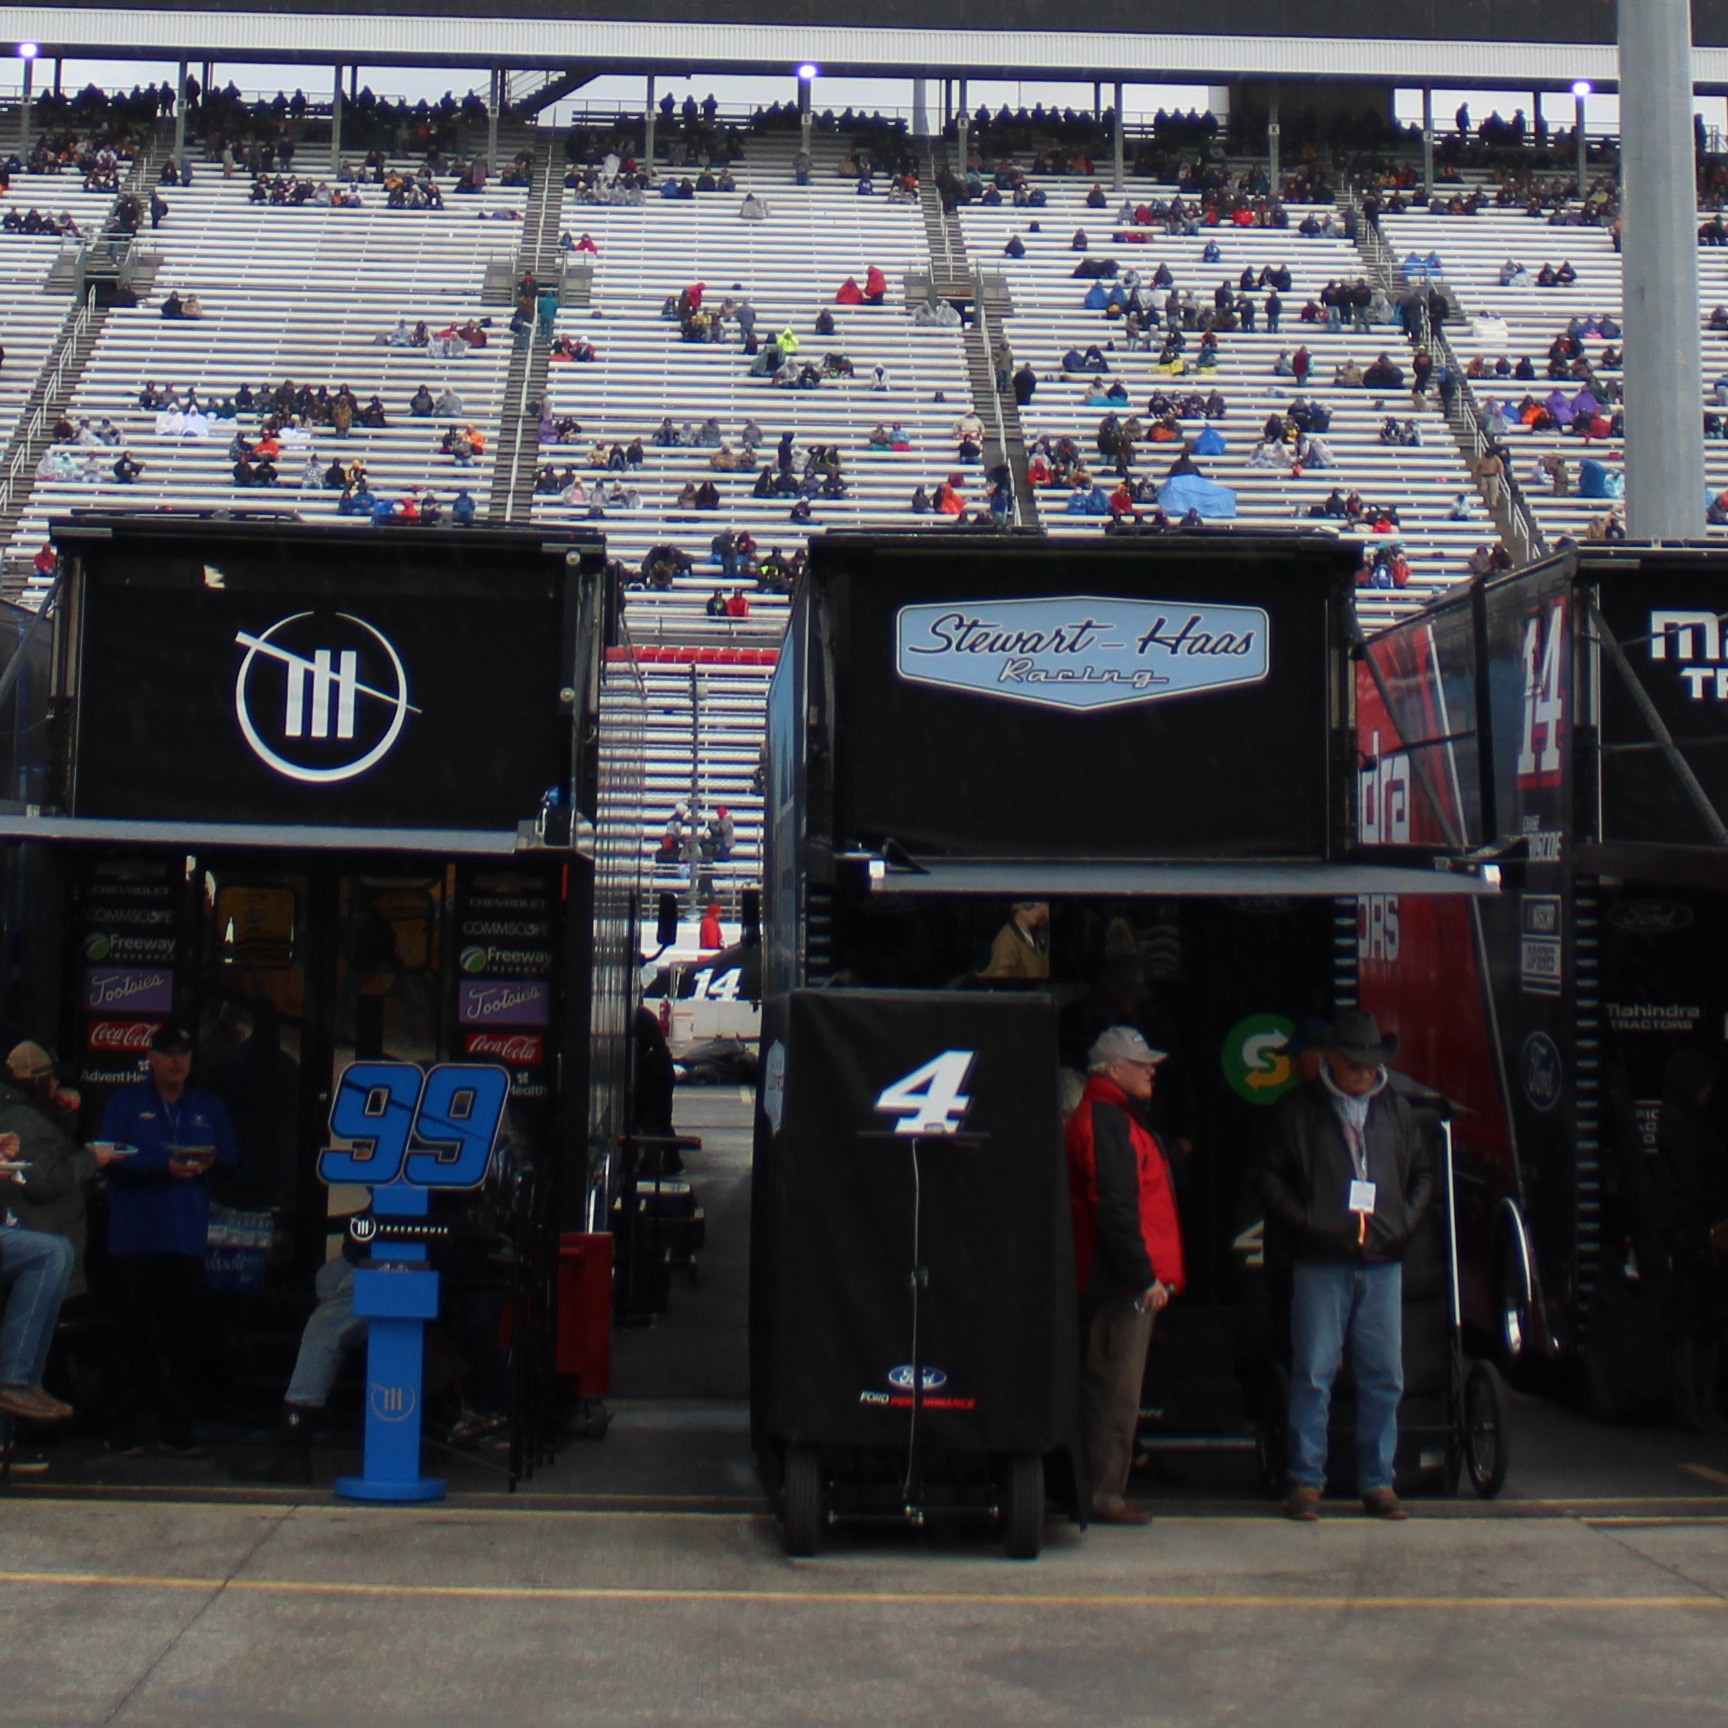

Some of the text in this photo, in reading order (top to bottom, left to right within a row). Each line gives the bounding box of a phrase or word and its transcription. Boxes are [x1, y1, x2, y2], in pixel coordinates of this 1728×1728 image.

[998, 658, 1169, 689] Racing
[1517, 598, 1569, 788] 14
[110, 933, 176, 953] Freeway
[487, 946, 553, 967] Freeway
[691, 968, 741, 1002] 14
[1605, 1003, 1700, 1019] Mahindra
[1609, 1018, 1693, 1031] TRACTORS
[874, 1049, 977, 1135] 4
[317, 1060, 512, 1191] 99
[378, 1223, 450, 1236] TRACKHOUSE
[859, 1390, 891, 1405] FORD
